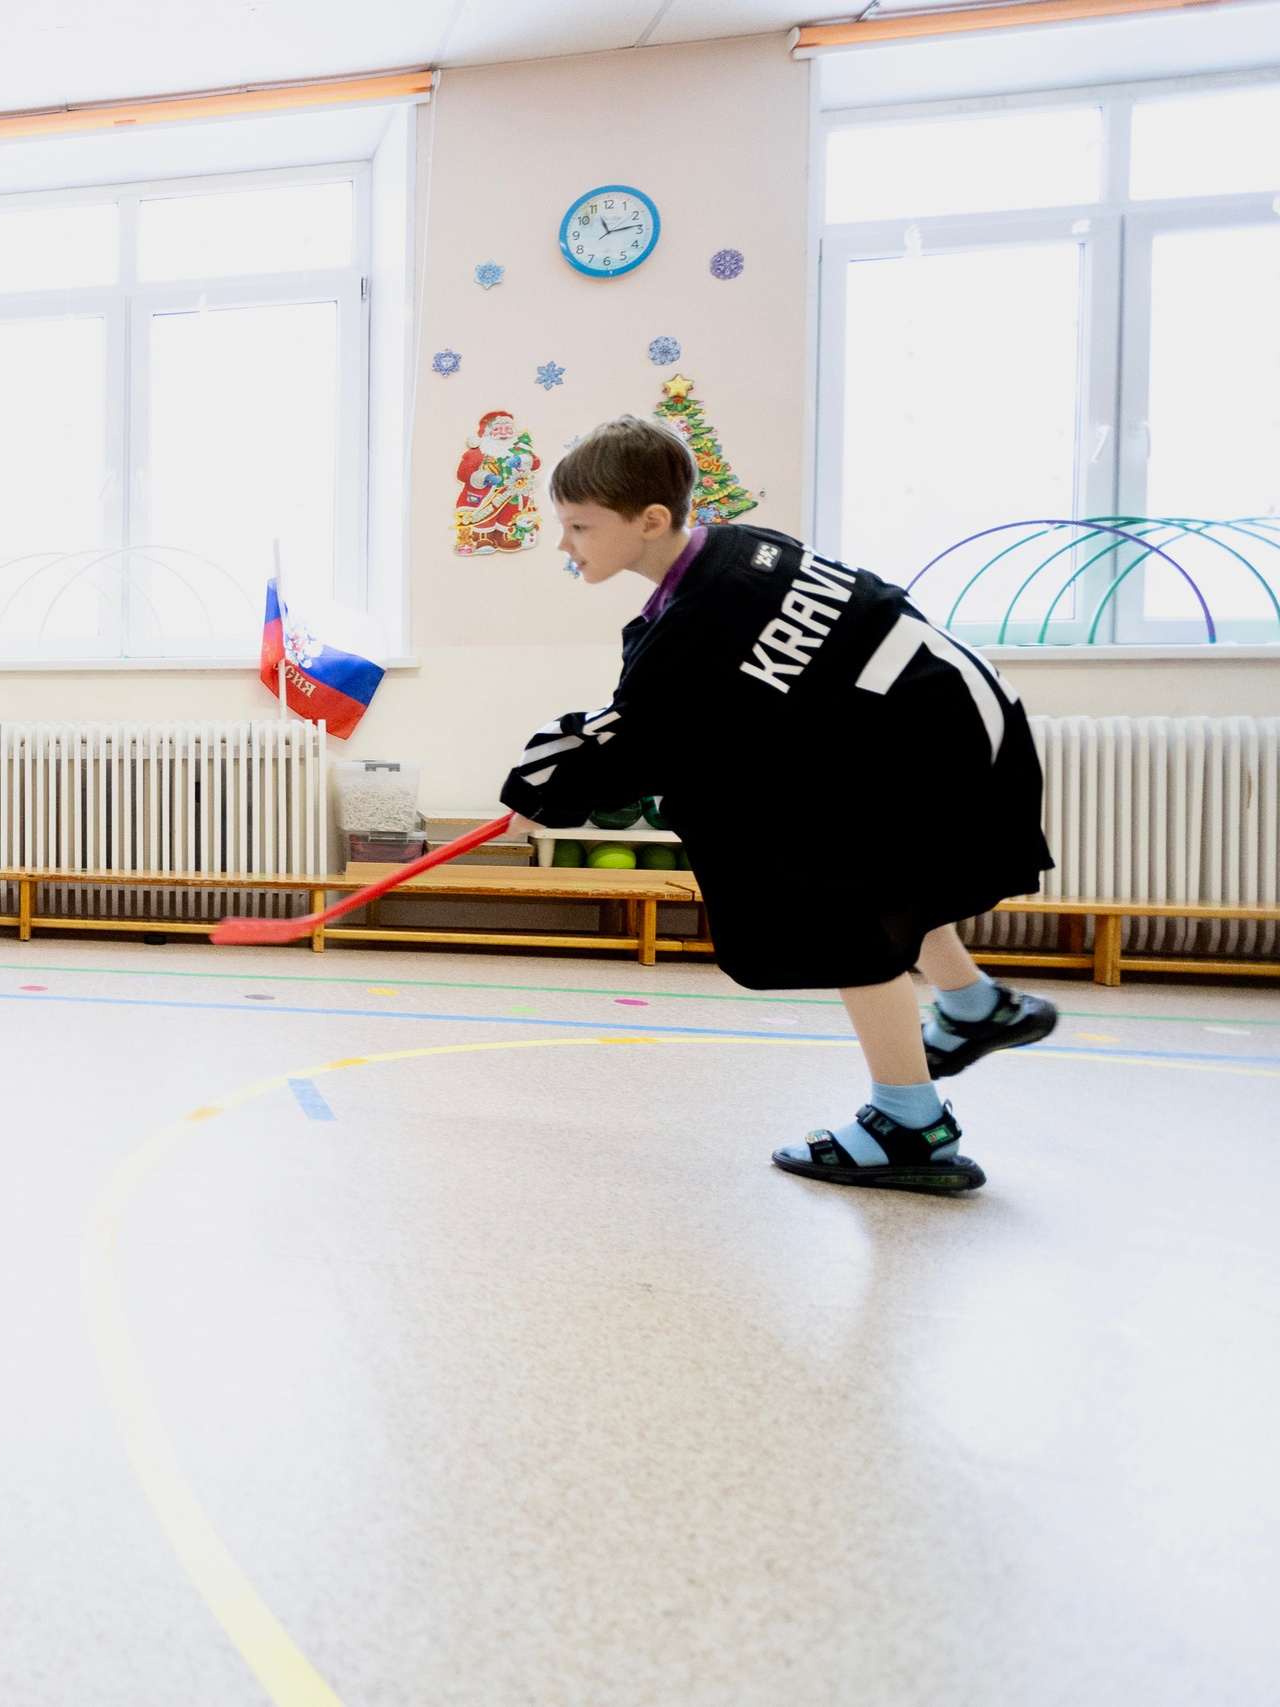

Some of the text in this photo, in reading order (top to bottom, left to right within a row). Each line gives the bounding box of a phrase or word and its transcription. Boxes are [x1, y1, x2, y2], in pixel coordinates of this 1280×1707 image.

[589, 204, 598, 214] 11
[603, 199, 615, 209] 12
[577, 215, 590, 226] 10
[632, 210, 640, 221] 2
[635, 224, 644, 235] 3
[572, 230, 580, 240] 9
[576, 244, 584, 255] 8
[631, 240, 639, 249] 4
[588, 254, 595, 264] 7
[603, 256, 611, 266] 6
[619, 251, 627, 261] 5
